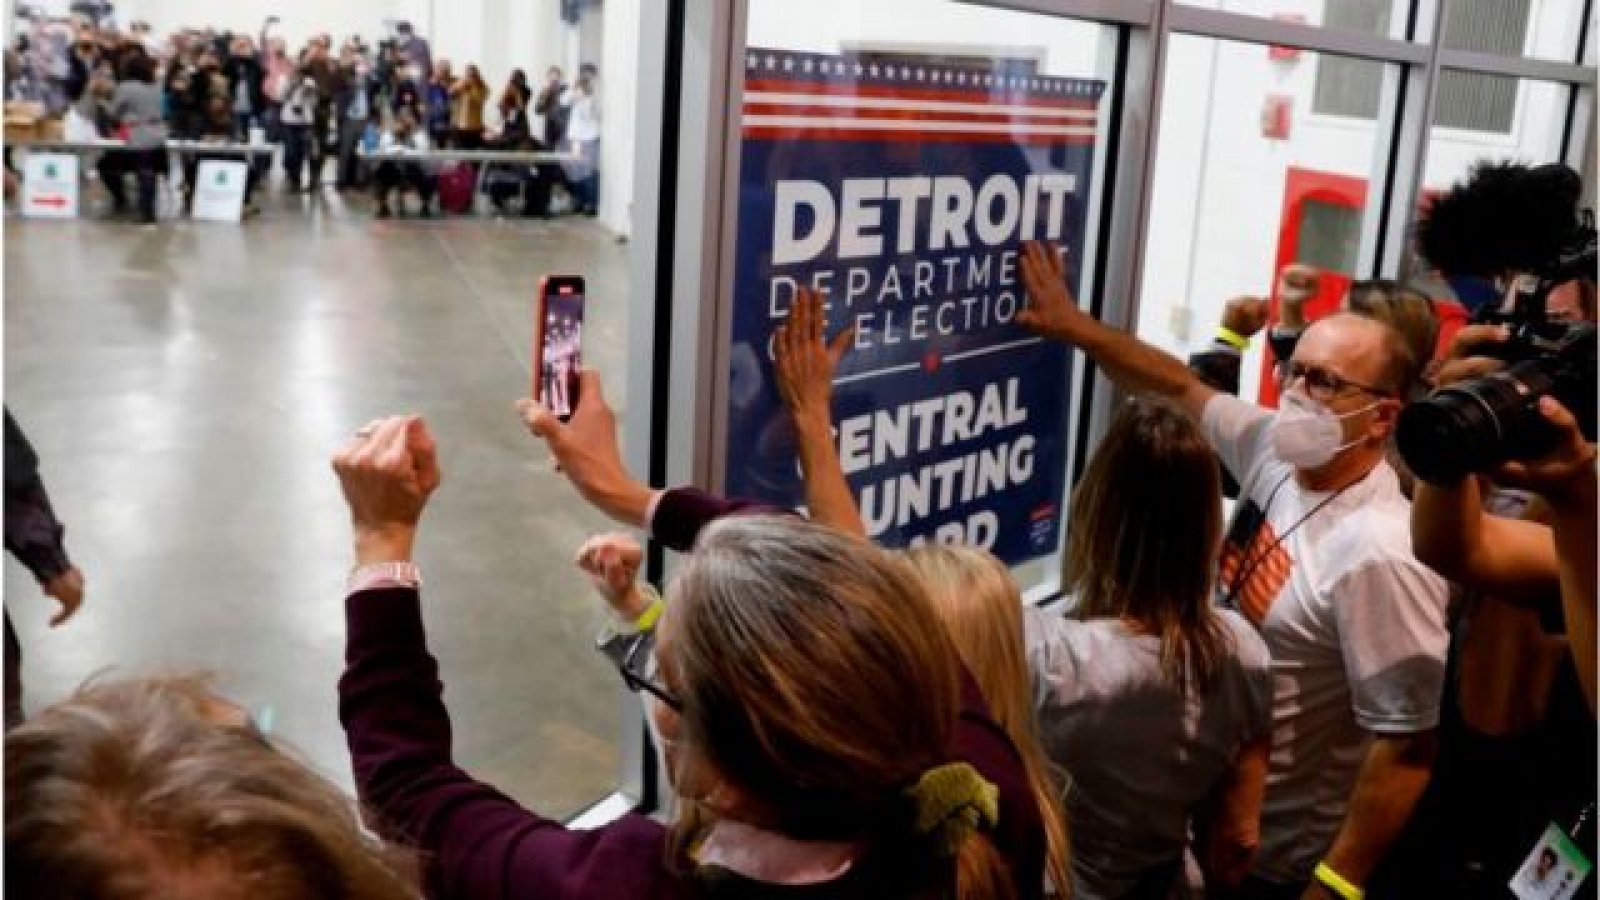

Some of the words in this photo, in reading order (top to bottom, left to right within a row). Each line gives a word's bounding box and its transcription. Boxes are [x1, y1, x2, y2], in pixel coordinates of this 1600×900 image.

[771, 174, 1076, 265] DETROIT
[769, 245, 1068, 318] DEPARTME
[854, 290, 1029, 350] ELECTIO
[831, 377, 1028, 474] ENTRAL
[797, 434, 1036, 536] UNTING
